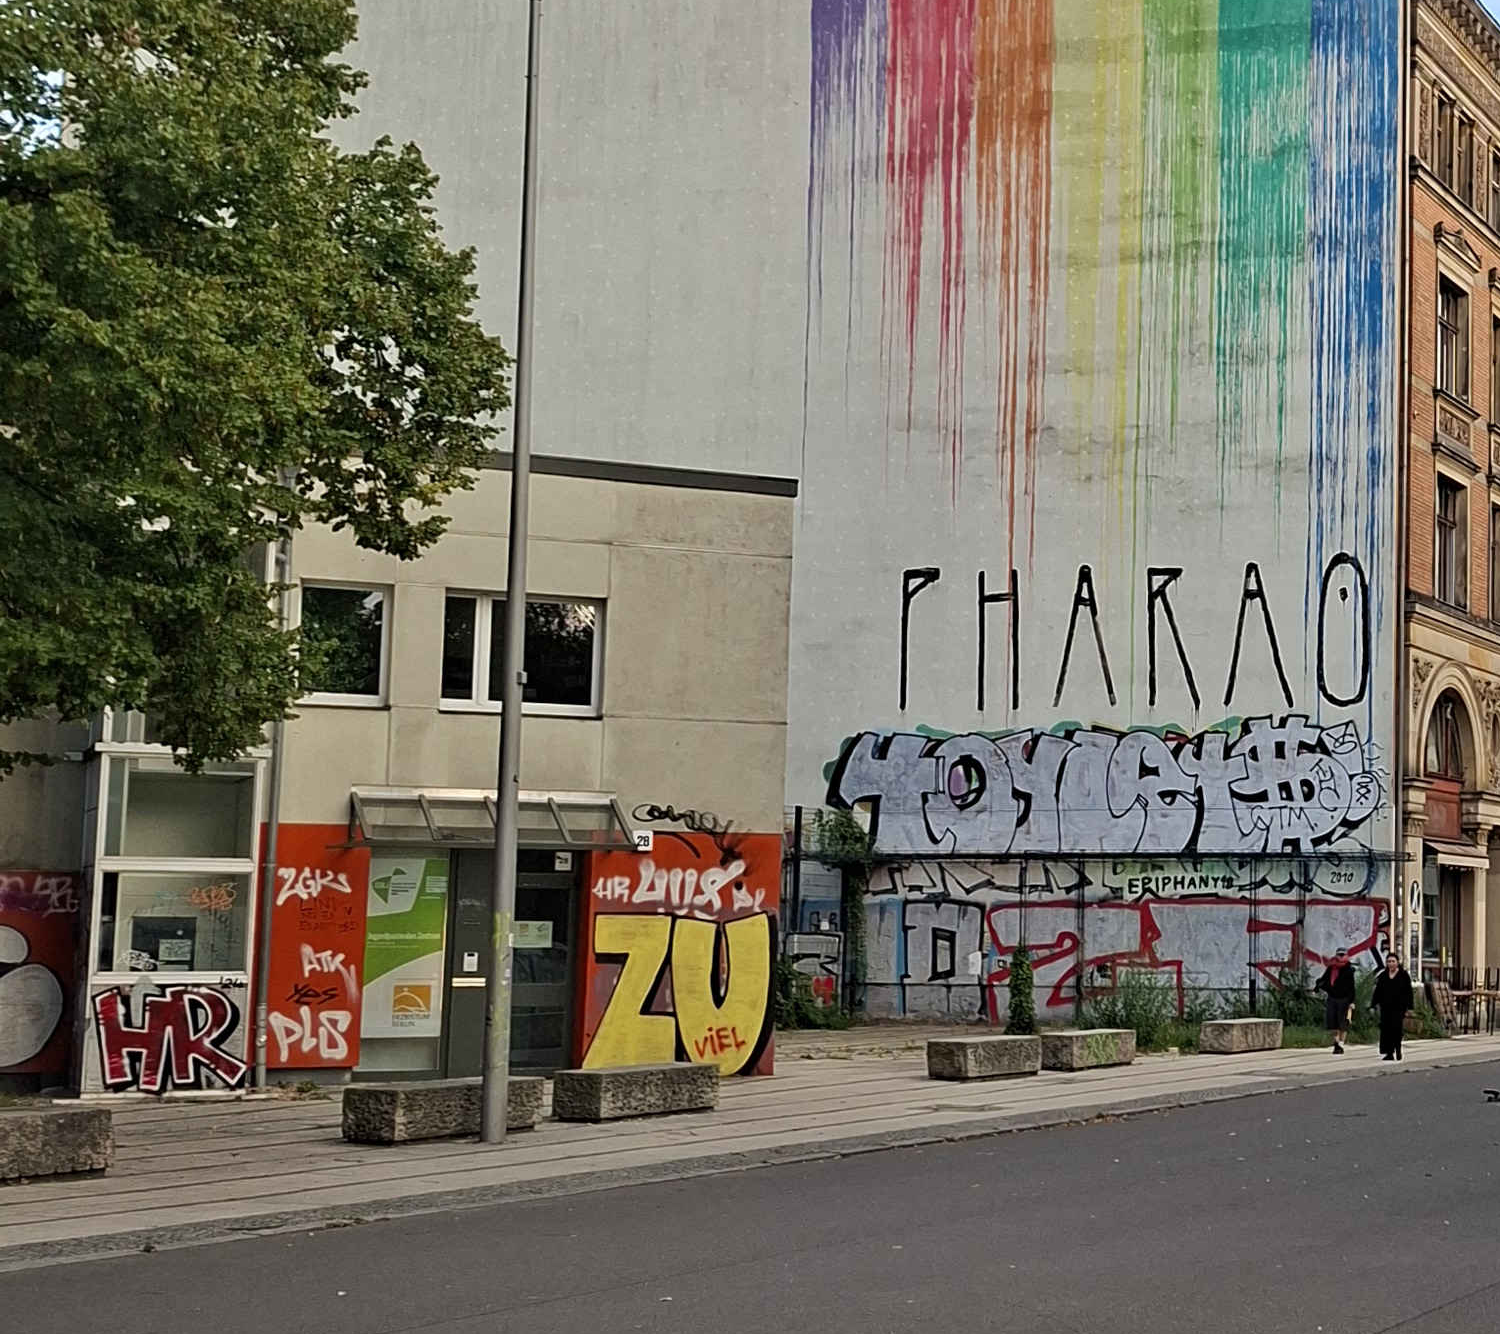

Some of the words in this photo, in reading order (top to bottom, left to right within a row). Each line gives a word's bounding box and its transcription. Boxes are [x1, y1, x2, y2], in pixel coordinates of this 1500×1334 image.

[899, 551, 1370, 712] PHARAO
[636, 835, 650, 847] 28
[1330, 871, 1354, 884] 2010
[92, 984, 248, 1095] HR
[583, 911, 778, 1077] ZU
